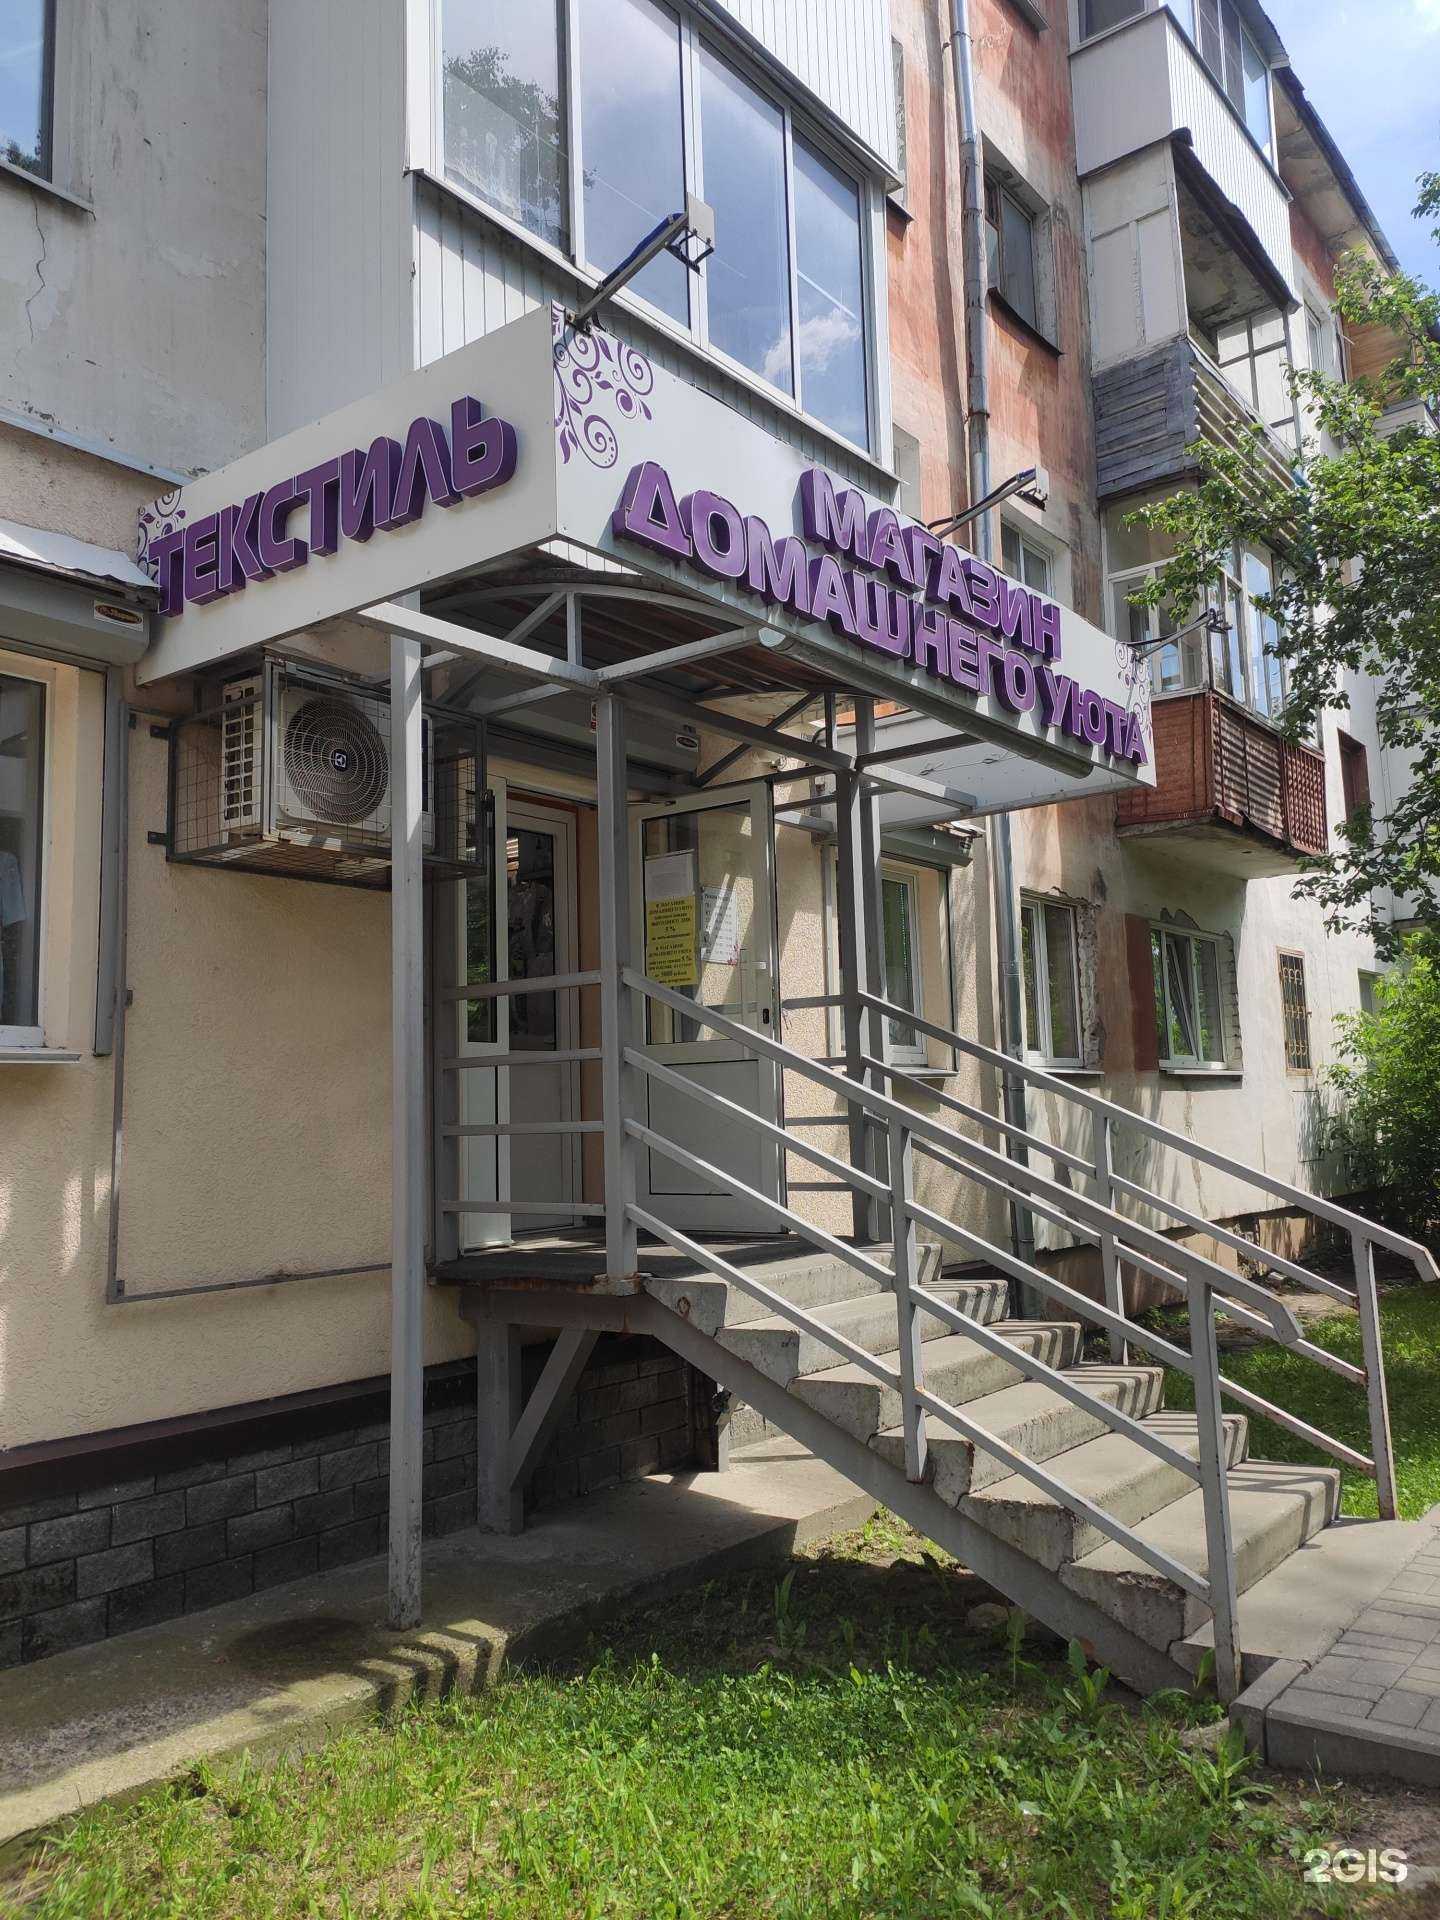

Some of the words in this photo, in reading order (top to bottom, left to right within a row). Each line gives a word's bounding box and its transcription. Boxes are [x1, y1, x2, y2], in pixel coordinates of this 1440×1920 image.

[147, 395, 518, 618] ТЕКСТИЛЬ
[612, 461, 1036, 713] ДОМАШНЕГО
[1034, 665, 1149, 767] УЮТА
[800, 468, 1062, 663] МАГАЗИН
